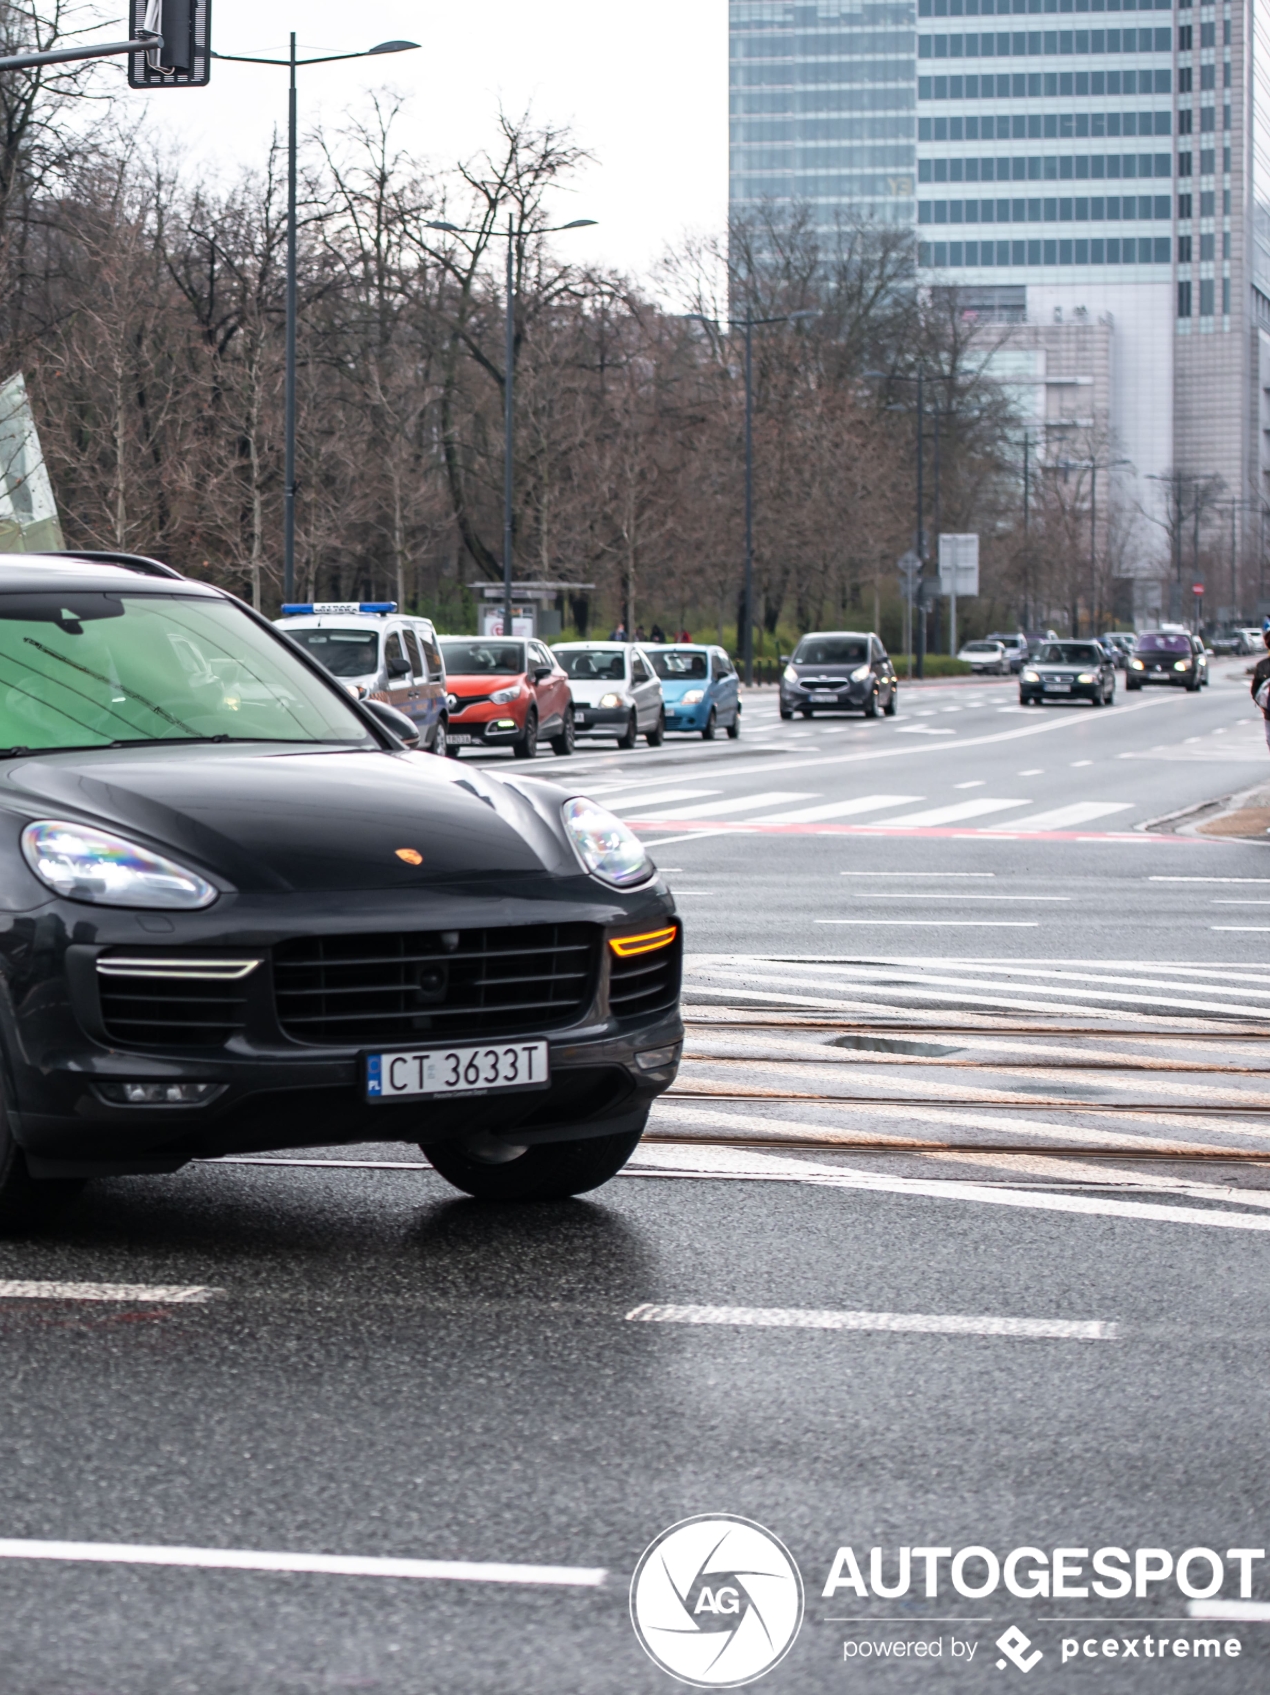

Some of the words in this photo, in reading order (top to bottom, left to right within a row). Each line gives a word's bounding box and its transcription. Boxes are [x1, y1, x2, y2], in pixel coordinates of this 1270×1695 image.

[389, 1054, 430, 1091] CT
[444, 1046, 539, 1087] 3633T
[368, 1080, 381, 1091] PL
